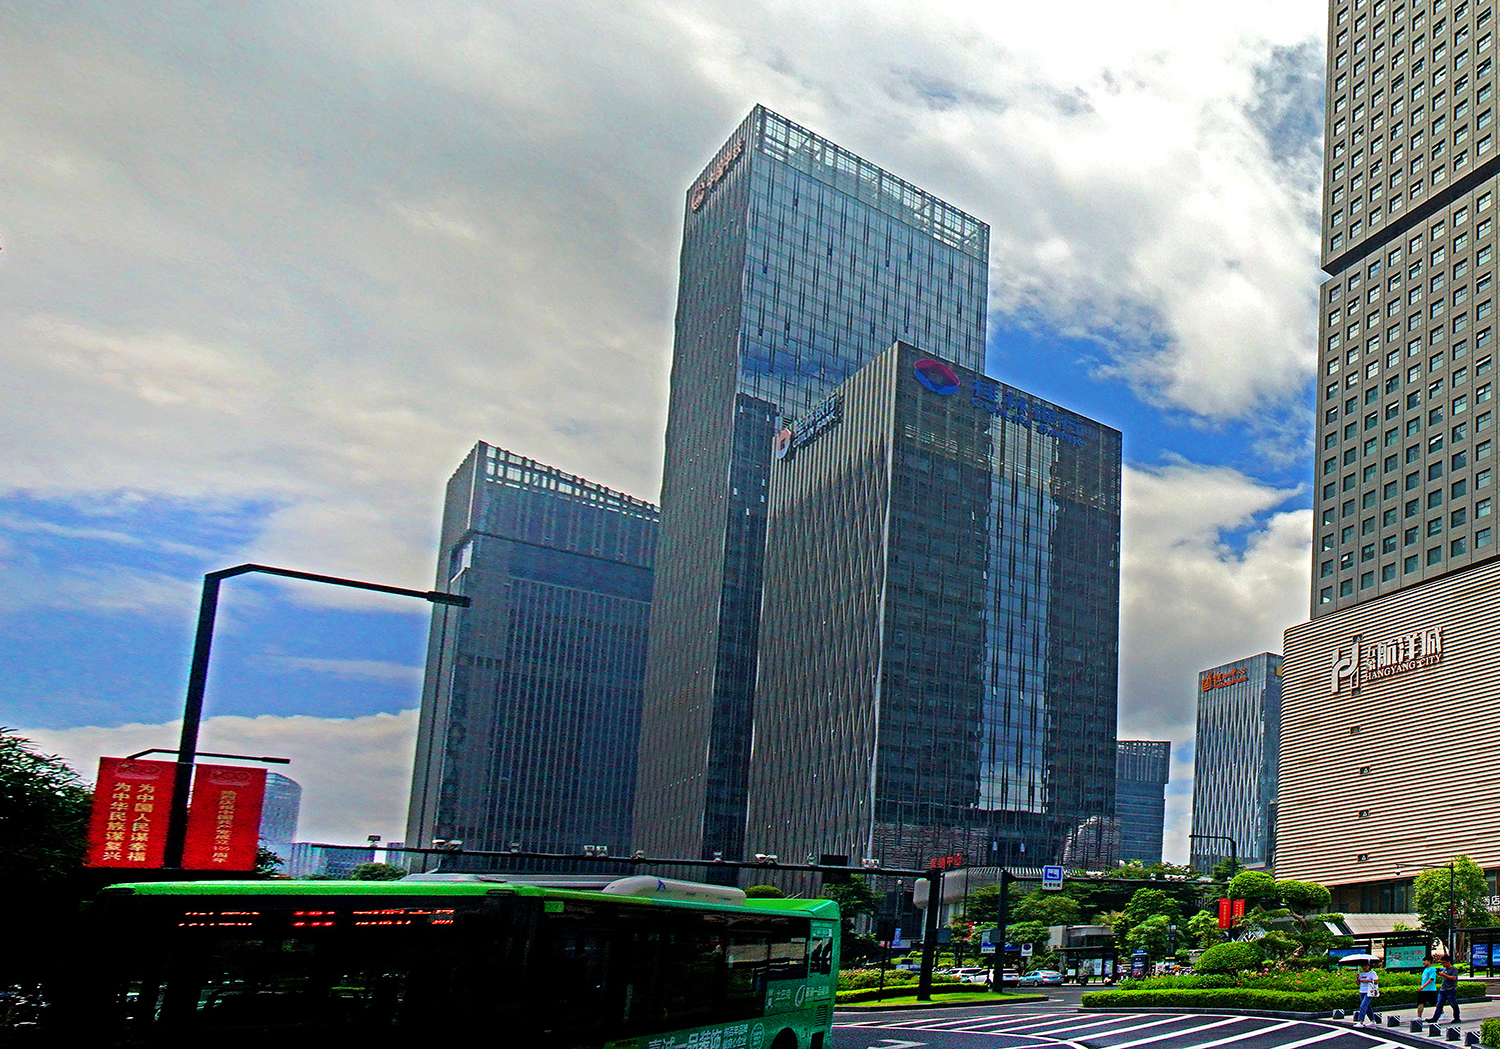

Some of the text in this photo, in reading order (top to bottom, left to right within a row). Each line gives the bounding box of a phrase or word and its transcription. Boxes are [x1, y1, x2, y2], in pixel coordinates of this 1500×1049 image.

[971, 379, 1082, 436] 桂林银行
[1365, 653, 1443, 681] HANGYANG CITY
[103, 782, 131, 860] 为中华民族谋复兴
[127, 783, 155, 861] 为中国人民谋幸福
